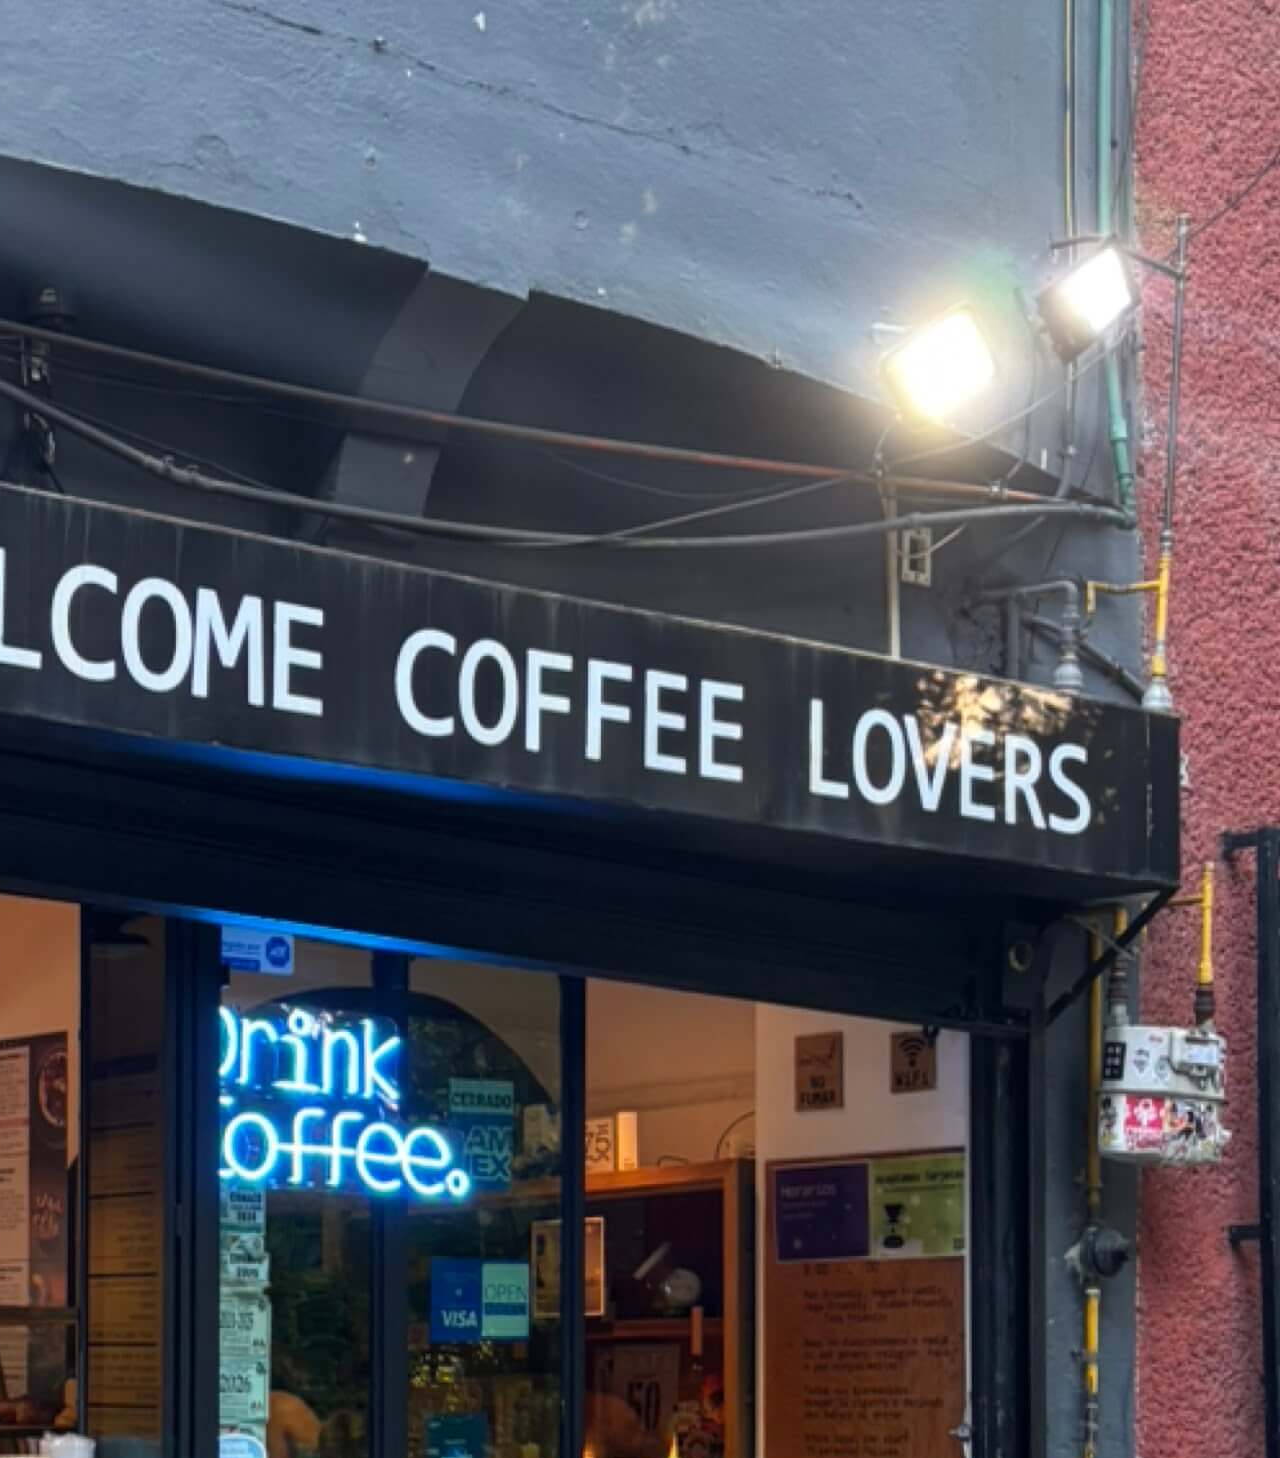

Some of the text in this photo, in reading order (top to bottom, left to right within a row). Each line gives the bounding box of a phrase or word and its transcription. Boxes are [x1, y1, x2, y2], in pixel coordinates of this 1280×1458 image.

[395, 629, 743, 782] COFFEE
[809, 699, 1092, 834] LOVERS
[485, 1283, 528, 1300] OPEN
[441, 1310, 478, 1328] VISA
